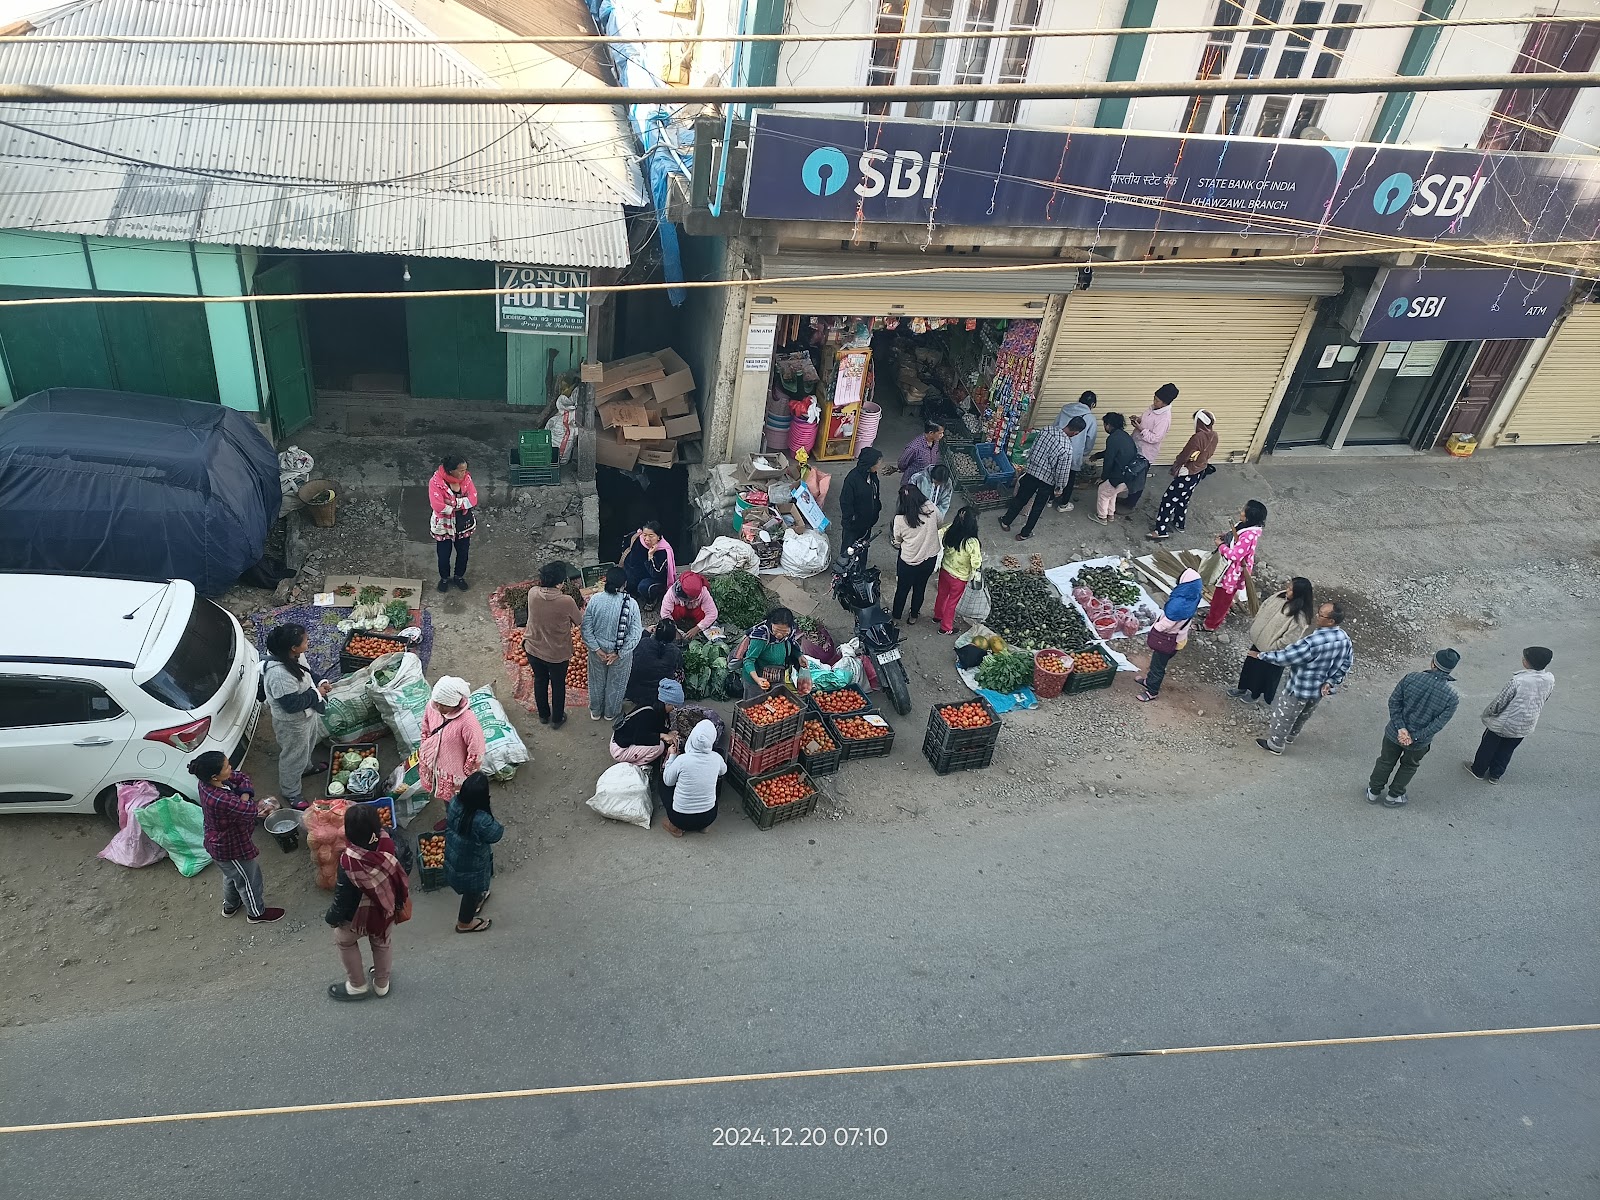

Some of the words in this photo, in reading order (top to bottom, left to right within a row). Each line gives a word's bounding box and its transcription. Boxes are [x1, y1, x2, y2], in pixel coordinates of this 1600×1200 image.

[853, 149, 942, 199] SBI
[1111, 172, 1141, 185] भारतीय
[1143, 173, 1162, 186] स्टेट
[1163, 173, 1179, 186] बैंक
[1197, 178, 1228, 189] STATE
[1228, 179, 1256, 190] BANK
[1256, 181, 1270, 190] OF
[1270, 182, 1296, 191] INDIA
[1191, 197, 1247, 209] KHAWZAWL
[1247, 200, 1289, 210] BRANCH
[1410, 174, 1488, 218] SBI
[503, 268, 585, 298] ZONUN
[504, 282, 580, 309] HOTEL
[1407, 296, 1447, 318] SBI
[1524, 306, 1548, 316] ATM
